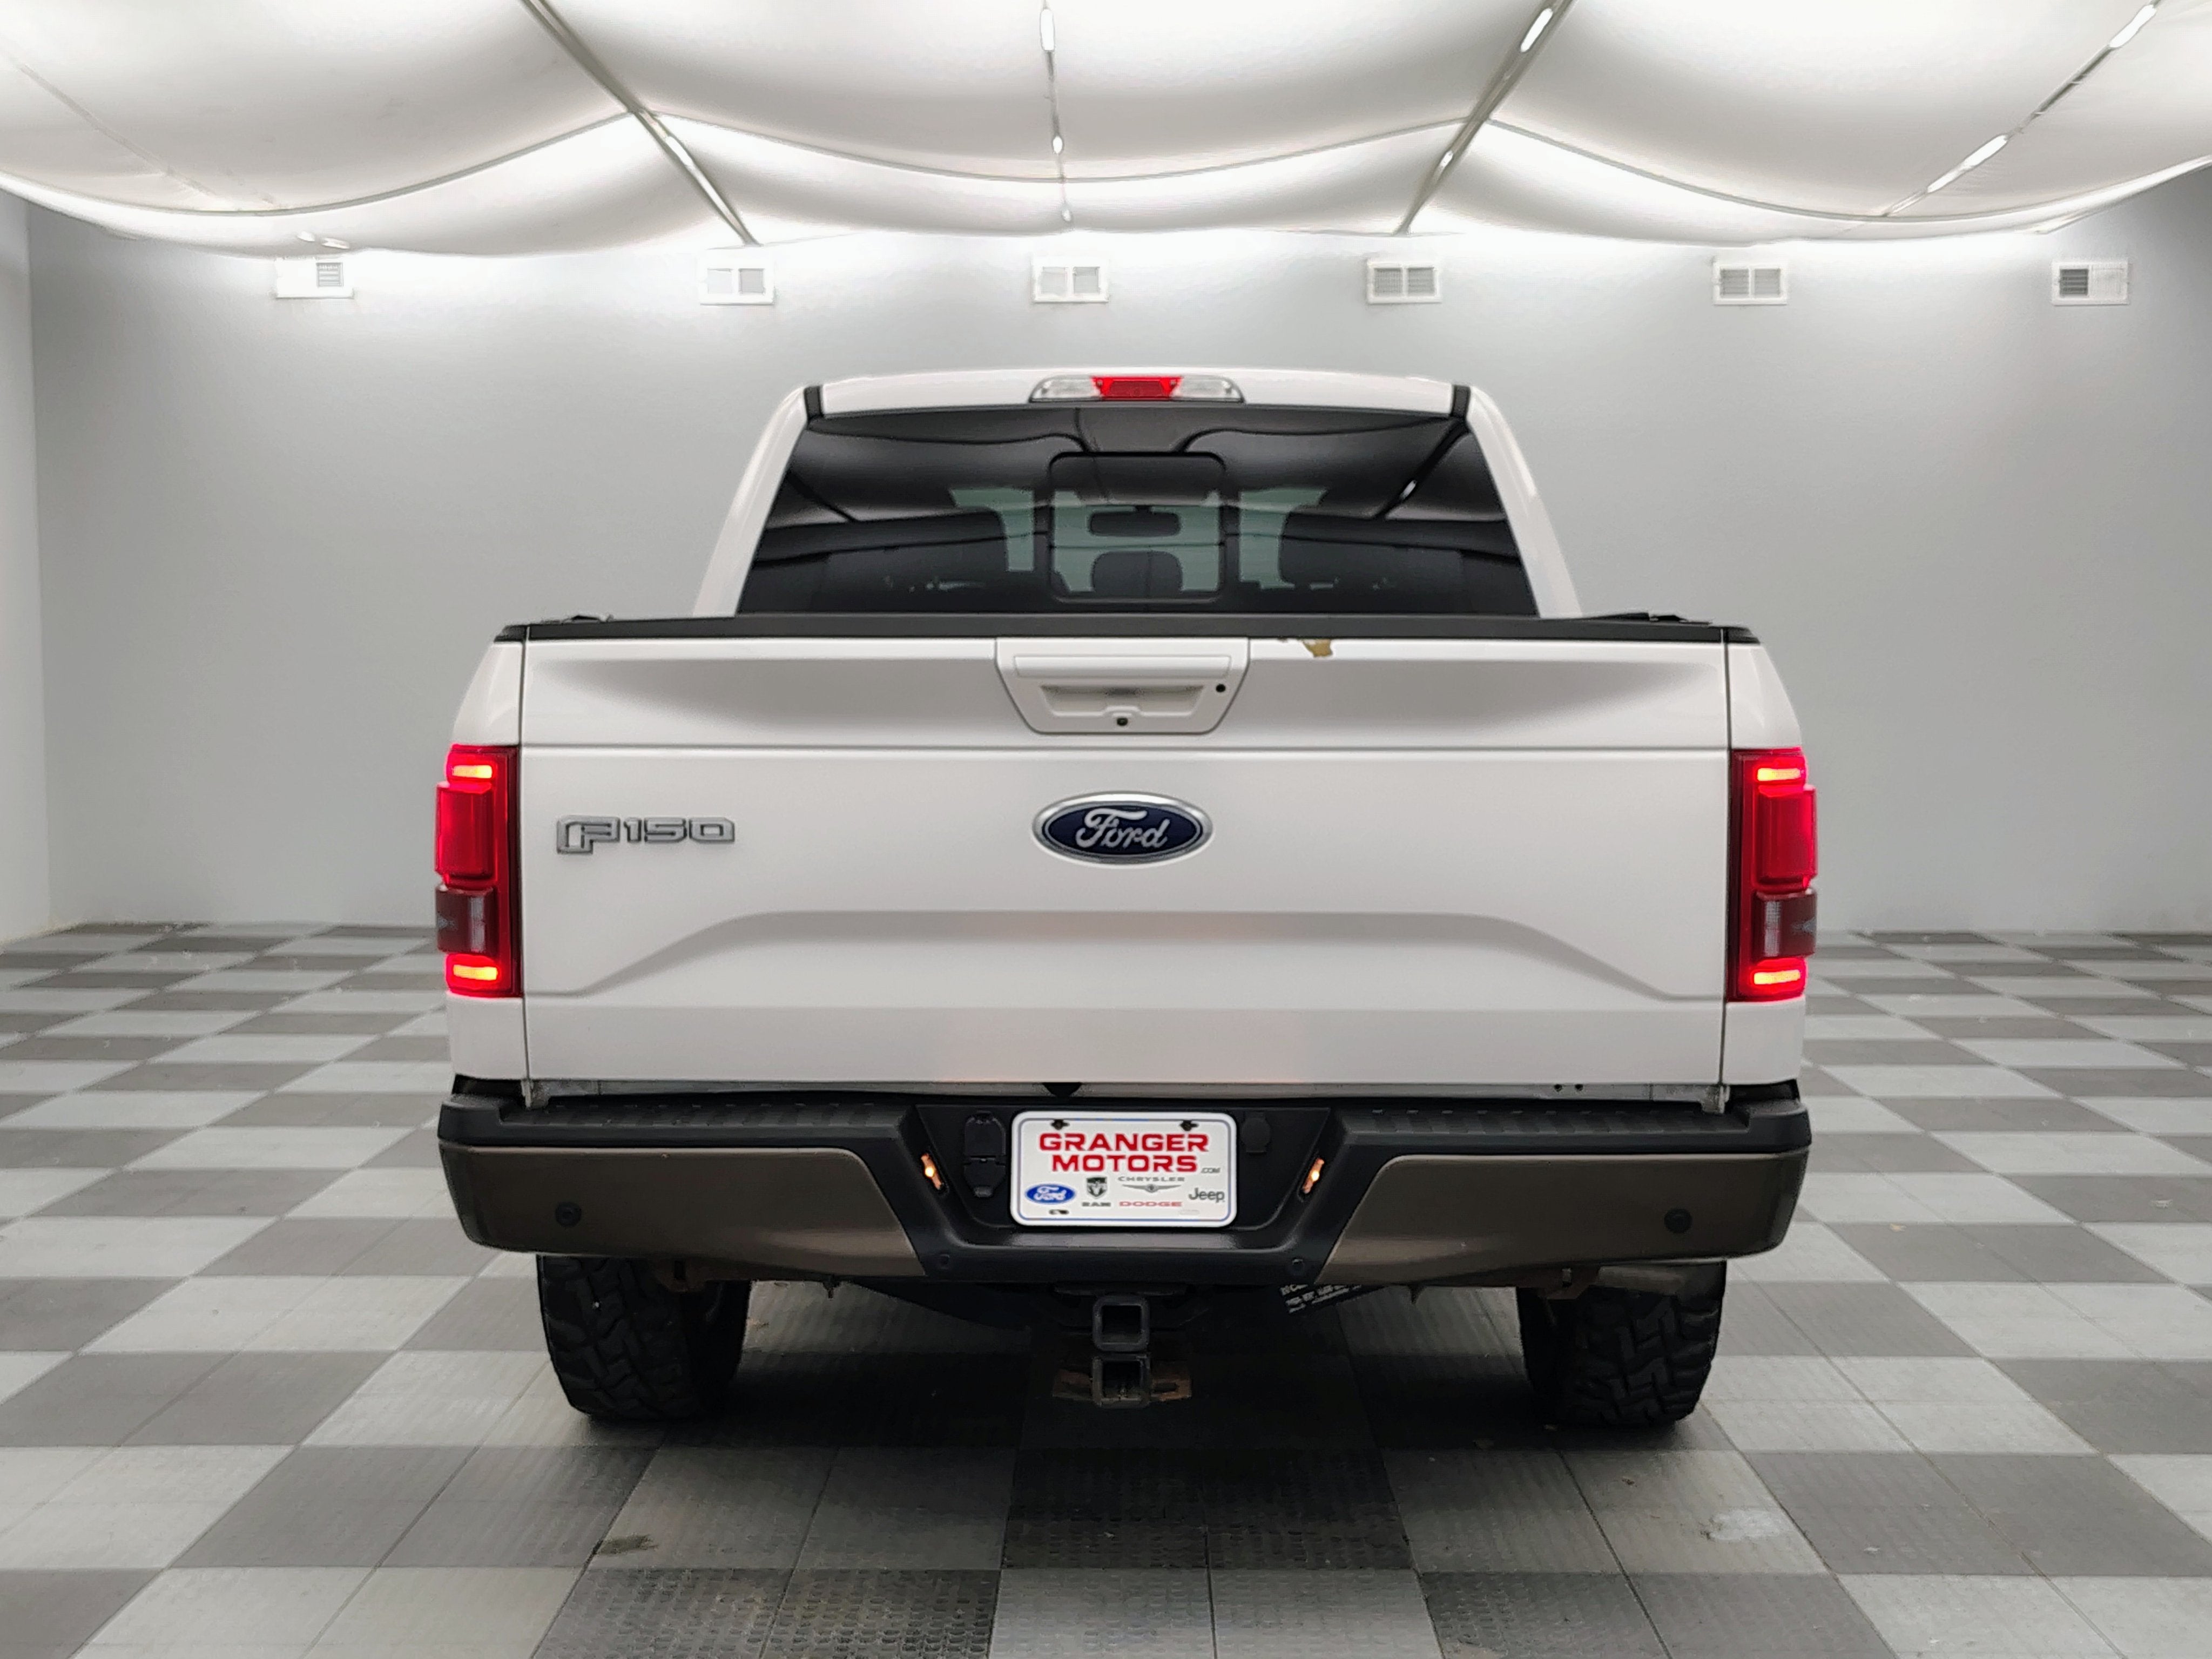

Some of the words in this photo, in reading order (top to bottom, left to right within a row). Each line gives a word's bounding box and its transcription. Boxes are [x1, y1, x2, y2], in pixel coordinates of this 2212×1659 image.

[1075, 808, 1170, 848] Ford
[1039, 1133, 1209, 1152] GRANGER
[1051, 1154, 1198, 1172] MOTORS
[1032, 1186, 1068, 1201] Ford
[1189, 1188, 1225, 1203] Jeep
